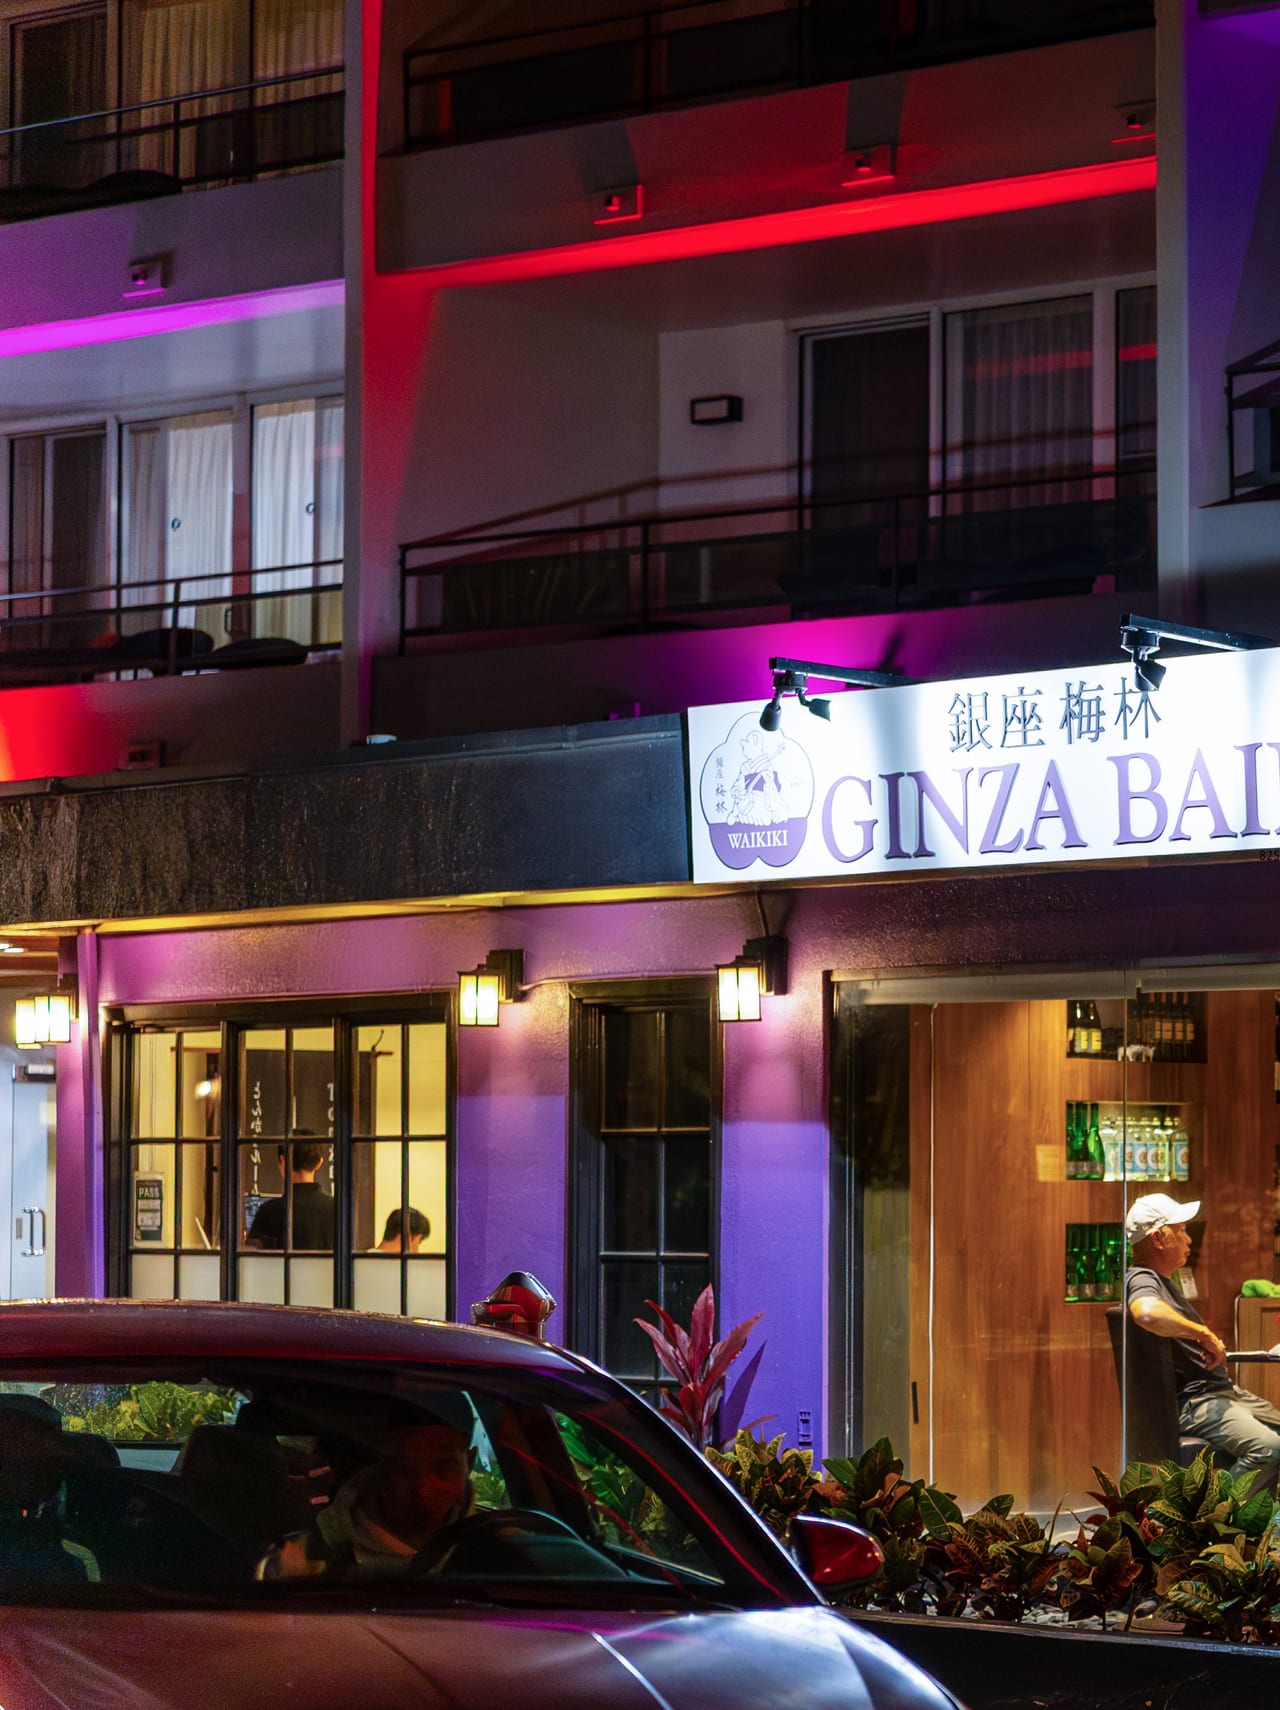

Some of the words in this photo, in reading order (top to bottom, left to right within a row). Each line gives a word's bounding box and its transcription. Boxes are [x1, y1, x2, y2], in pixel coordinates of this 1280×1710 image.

[948, 677, 1162, 752] 銀座梅林
[728, 830, 788, 849] WAIKIKI
[822, 759, 1088, 863] GINZA
